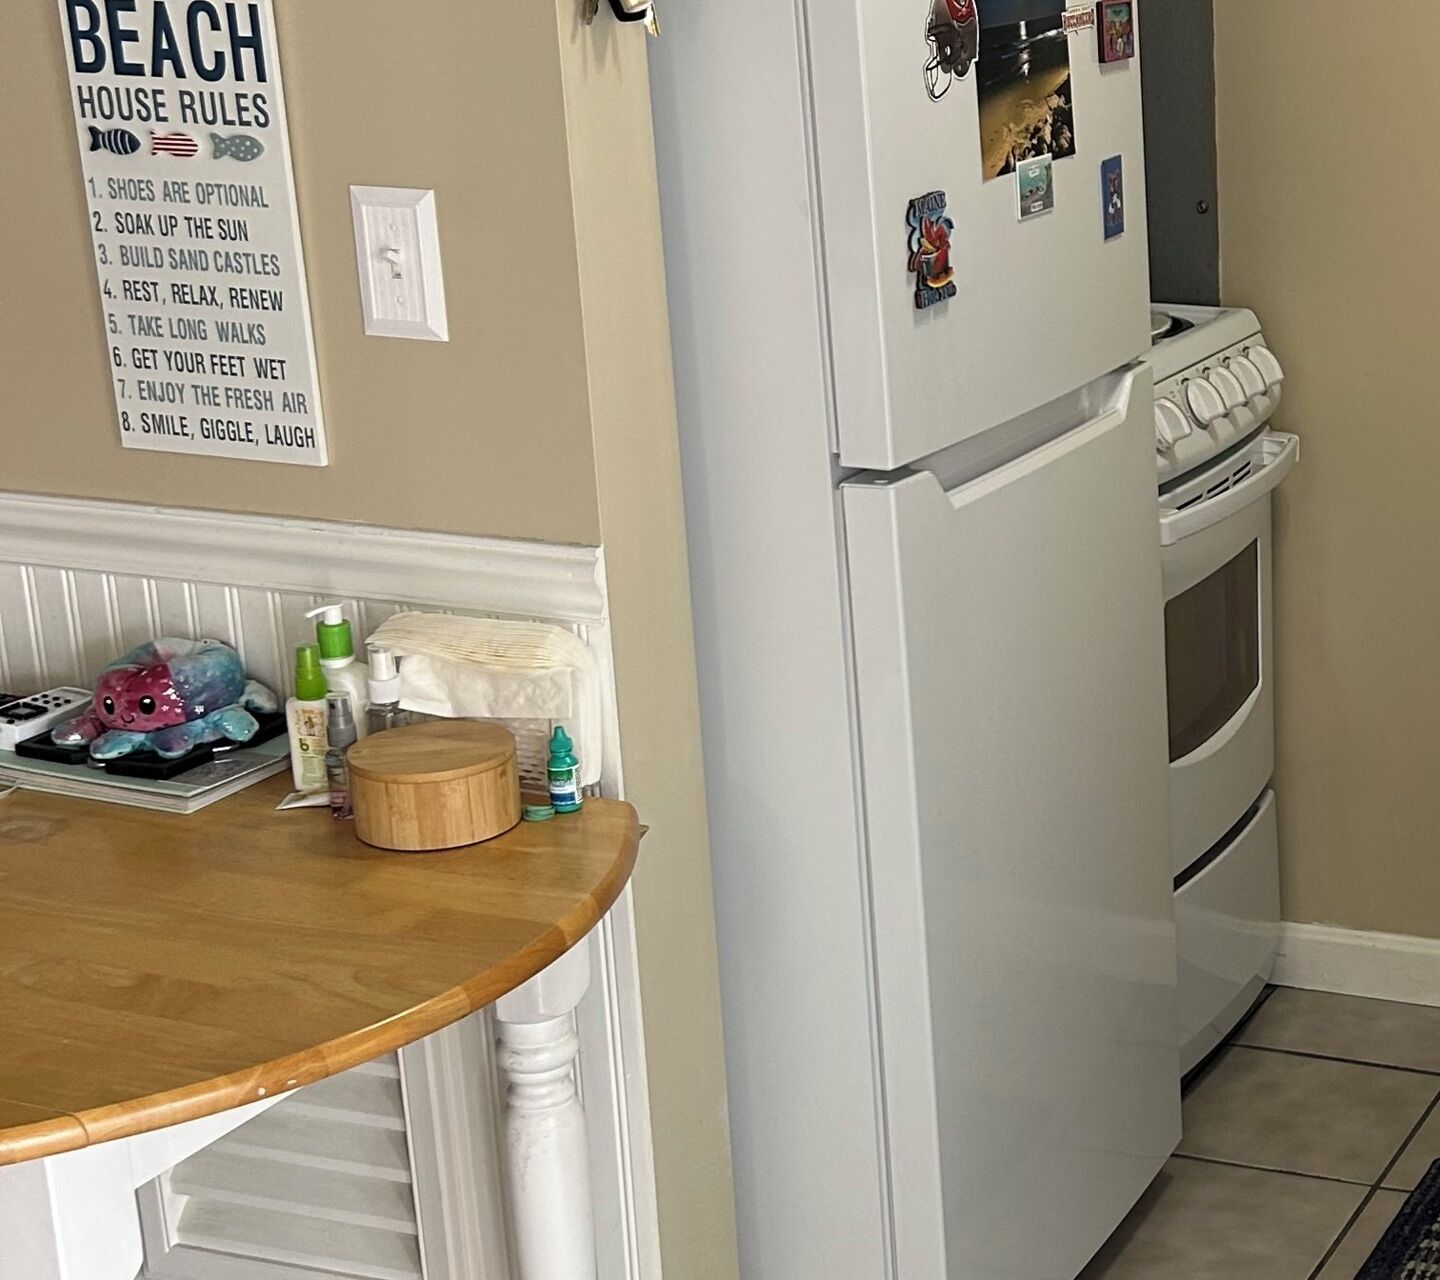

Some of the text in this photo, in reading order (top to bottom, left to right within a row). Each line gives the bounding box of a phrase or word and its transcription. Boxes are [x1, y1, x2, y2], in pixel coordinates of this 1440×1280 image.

[77, 85, 270, 128] HOUSE RULES
[88, 177, 269, 208] 1. SHOES ARE OPTIONAL
[914, 193, 946, 216] MAINE
[92, 211, 248, 241] 2. SOAK UP THE SUN
[98, 244, 280, 276] 3. BUILD SAND CASTLES
[102, 279, 282, 311] 4. REST, RELAX, RENEW
[108, 313, 266, 345] 5. TAKE LONG WALKS
[112, 347, 286, 380] 6. GET YOUR FEET WET
[117, 379, 310, 414] 7. ENJOY THE FRESH AIR
[121, 411, 315, 448] 8. SMILE, GIGGLE, LAUGH
